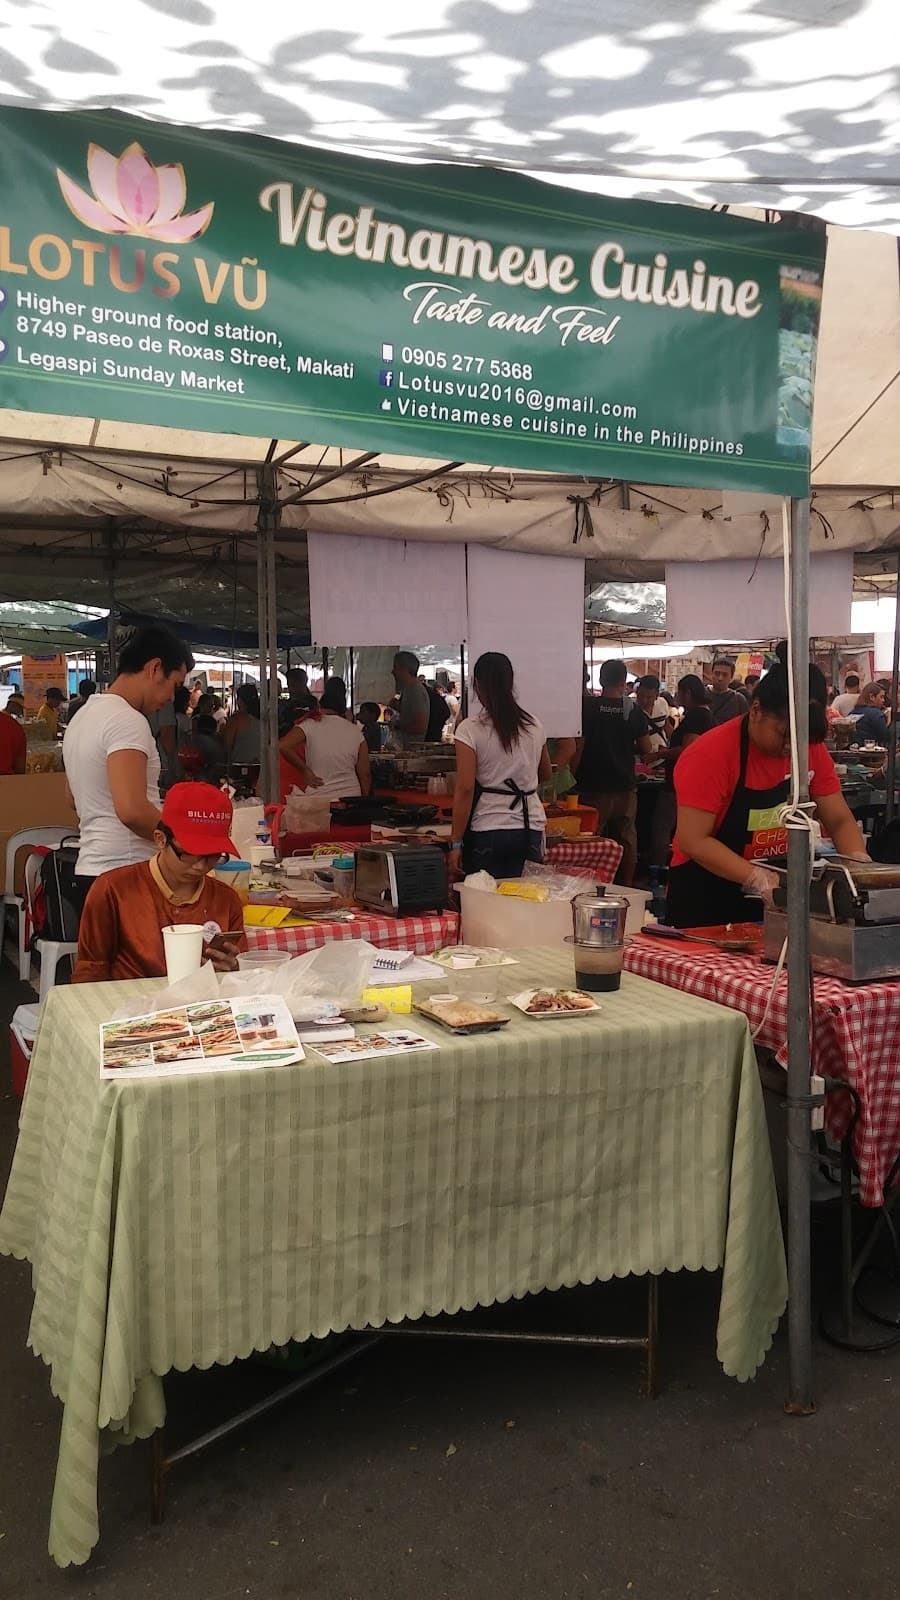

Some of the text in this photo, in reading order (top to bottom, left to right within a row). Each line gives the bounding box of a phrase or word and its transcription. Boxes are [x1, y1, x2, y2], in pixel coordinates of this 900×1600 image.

[0, 226, 267, 311] LOTUS VŨ
[259, 182, 763, 318] Vietnamese Cuisine
[17, 290, 283, 348] Higher ground food station,
[403, 281, 621, 346] Taste and Feel
[17, 316, 354, 379] 8749 Paseo de Roxas Street, Makati
[17, 347, 245, 394] Legaspi Sunday Market
[401, 347, 533, 381] 0905 277 5368
[399, 372, 637, 420] Lotusvu2016@gmail.com
[398, 399, 744, 456] Vietnamese cuisine in the Philippines
